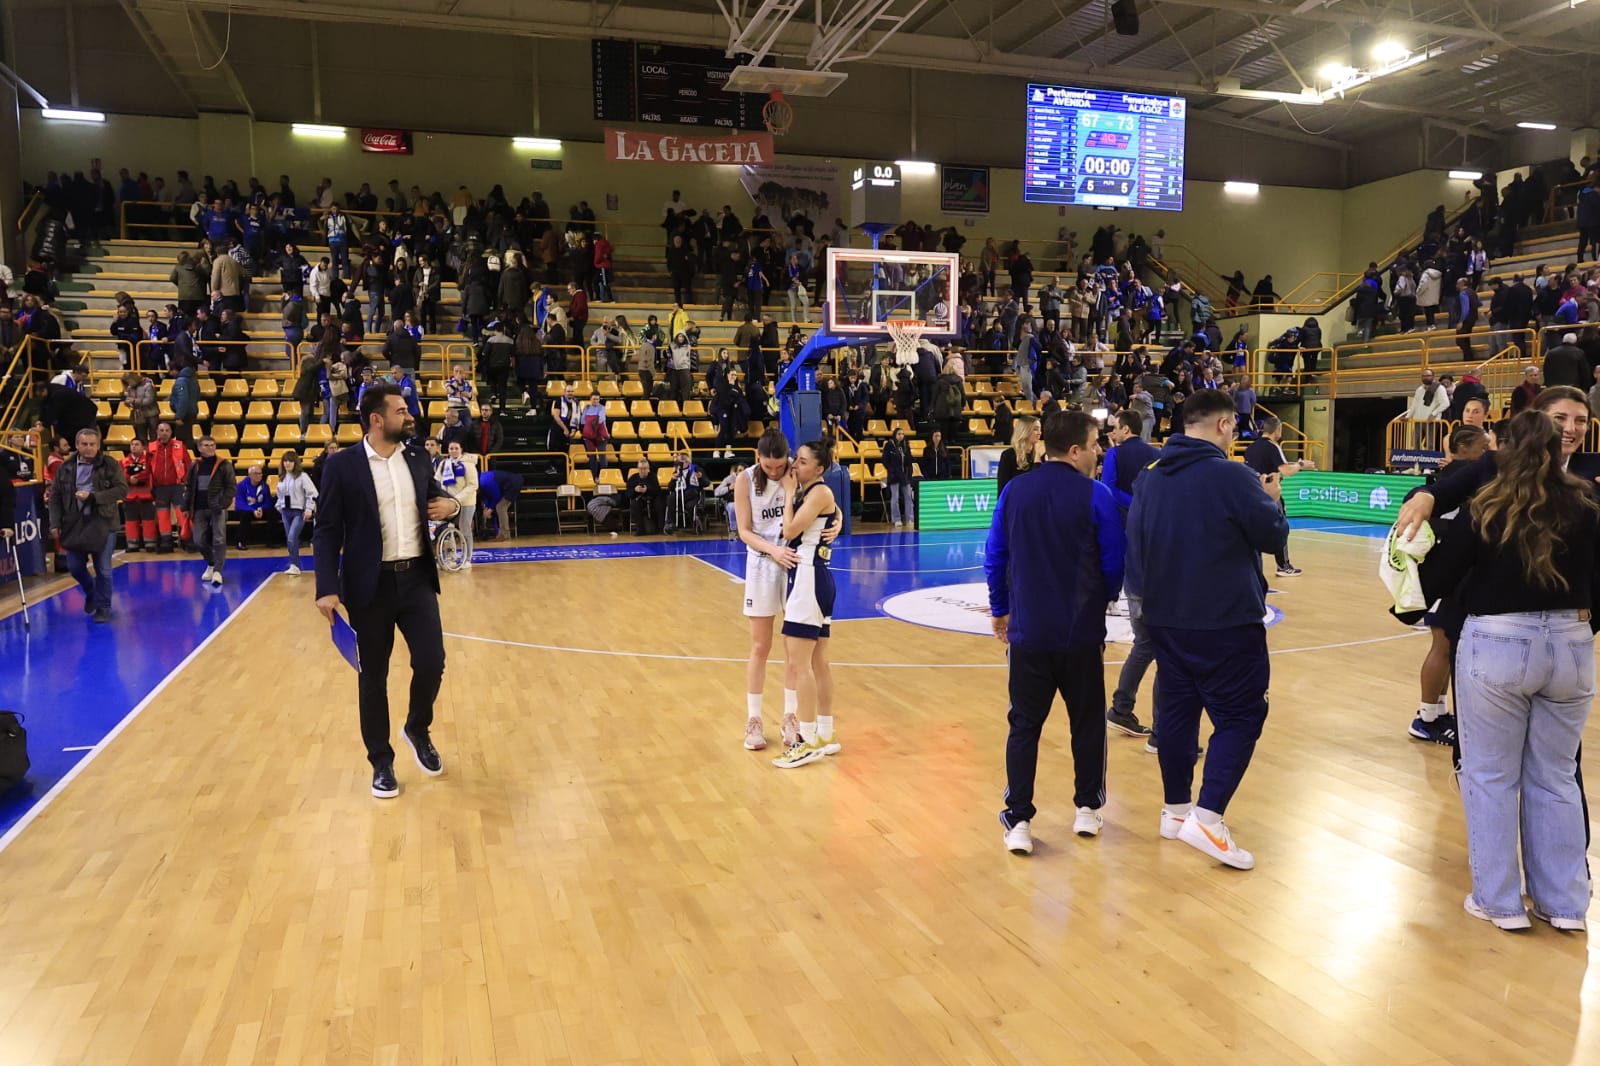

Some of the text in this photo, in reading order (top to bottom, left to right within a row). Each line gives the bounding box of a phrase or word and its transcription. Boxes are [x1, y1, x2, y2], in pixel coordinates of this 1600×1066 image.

[641, 65, 670, 75] LOCAL
[706, 70, 731, 80] VISITANT
[1053, 98, 1091, 107] AVENIDA
[642, 113, 662, 122] FALTAS
[714, 118, 734, 127] FALTAS
[1082, 113, 1135, 131] 67 73
[615, 131, 764, 162] LA GACETA
[1085, 157, 1130, 175] 00:00
[873, 166, 893, 178] 0.0
